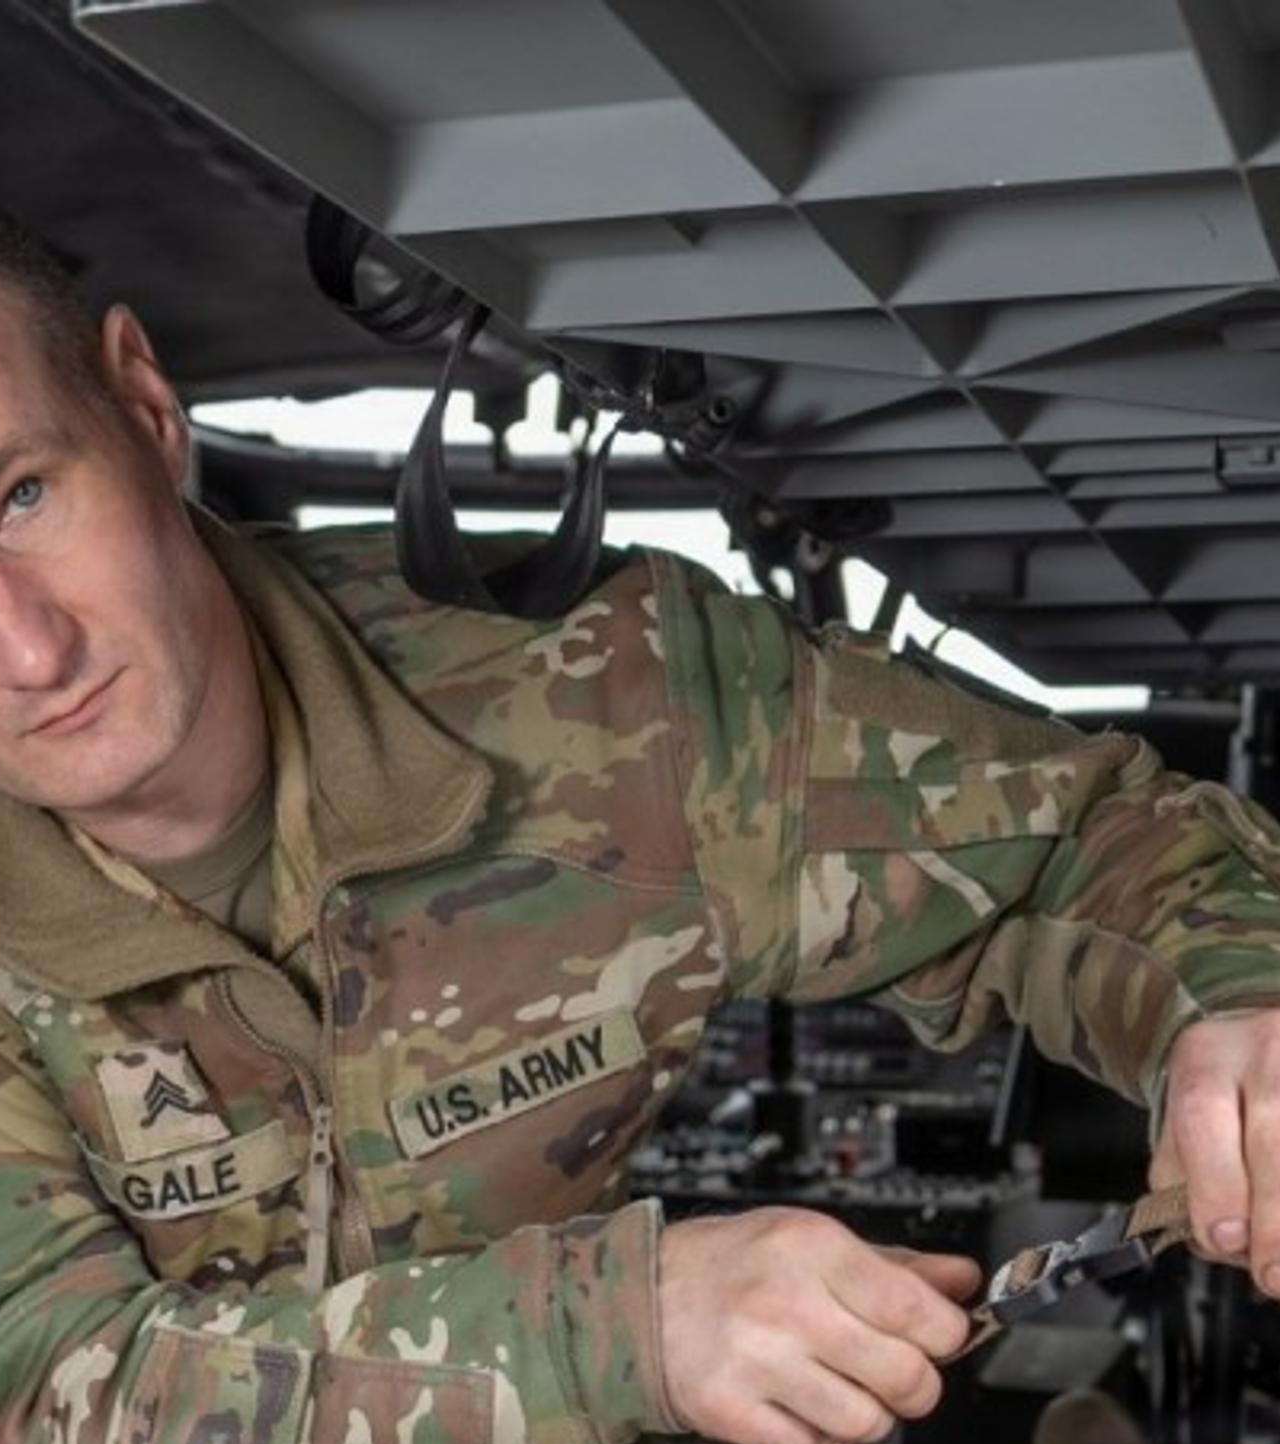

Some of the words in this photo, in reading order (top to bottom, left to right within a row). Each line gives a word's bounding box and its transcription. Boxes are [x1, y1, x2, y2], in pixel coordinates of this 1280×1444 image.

[416, 1085, 489, 1139] U.S.
[498, 1026, 607, 1104] ARMY
[122, 1154, 240, 1211] GALE
